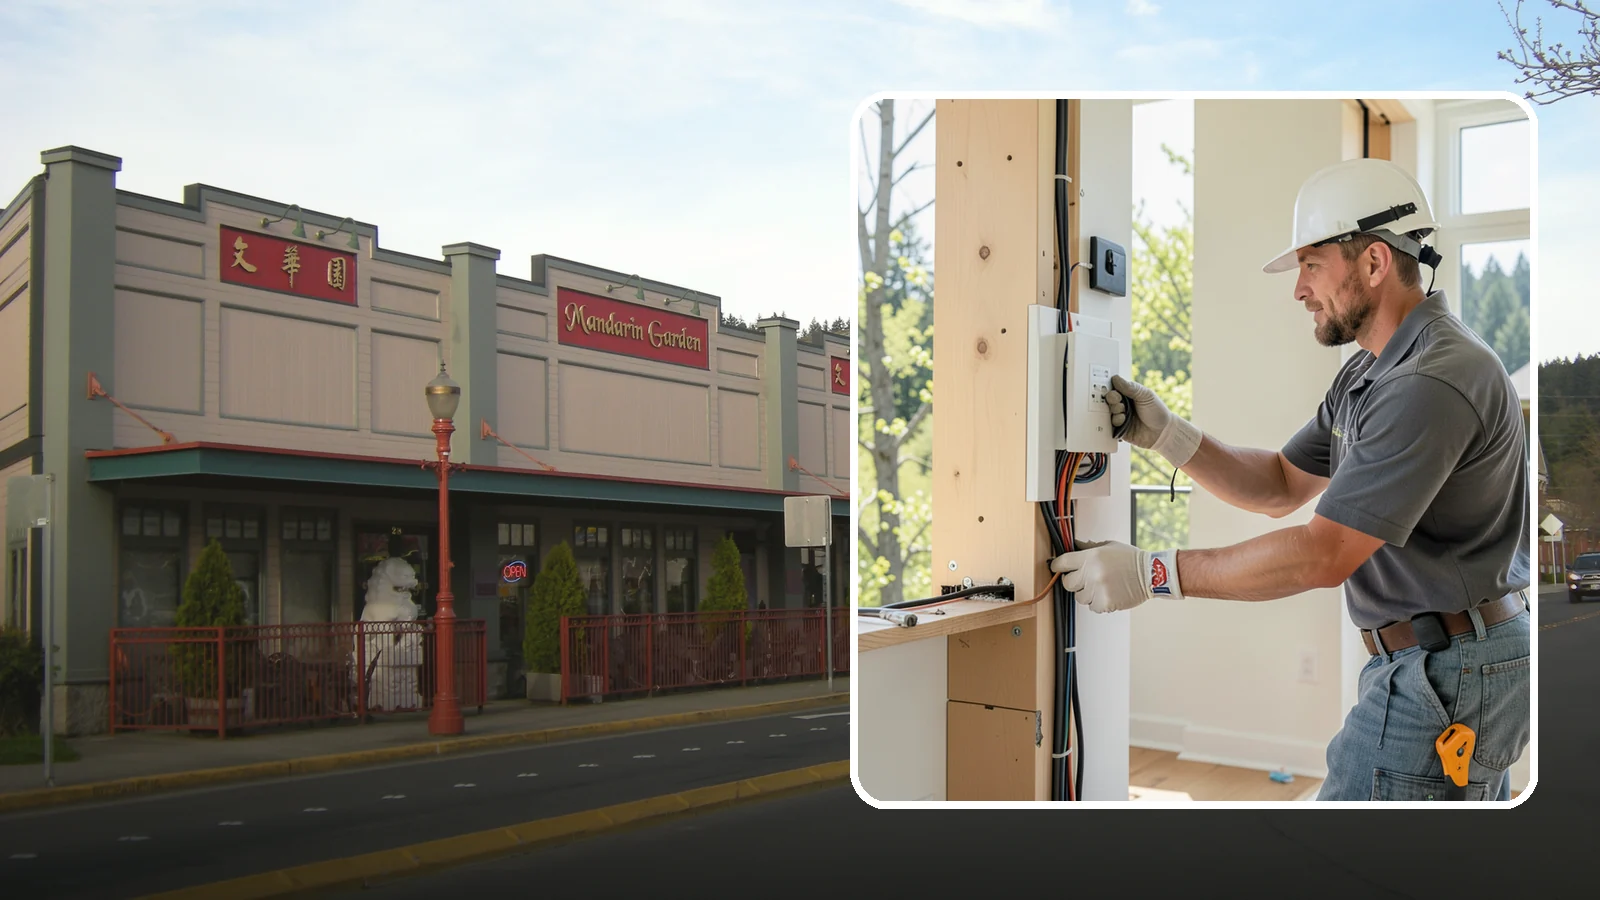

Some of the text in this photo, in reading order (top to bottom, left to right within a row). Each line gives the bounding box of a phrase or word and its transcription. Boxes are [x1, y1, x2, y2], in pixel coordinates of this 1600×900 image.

[564, 302, 701, 352] Mandarin Garden
[503, 565, 527, 578] OPEN
